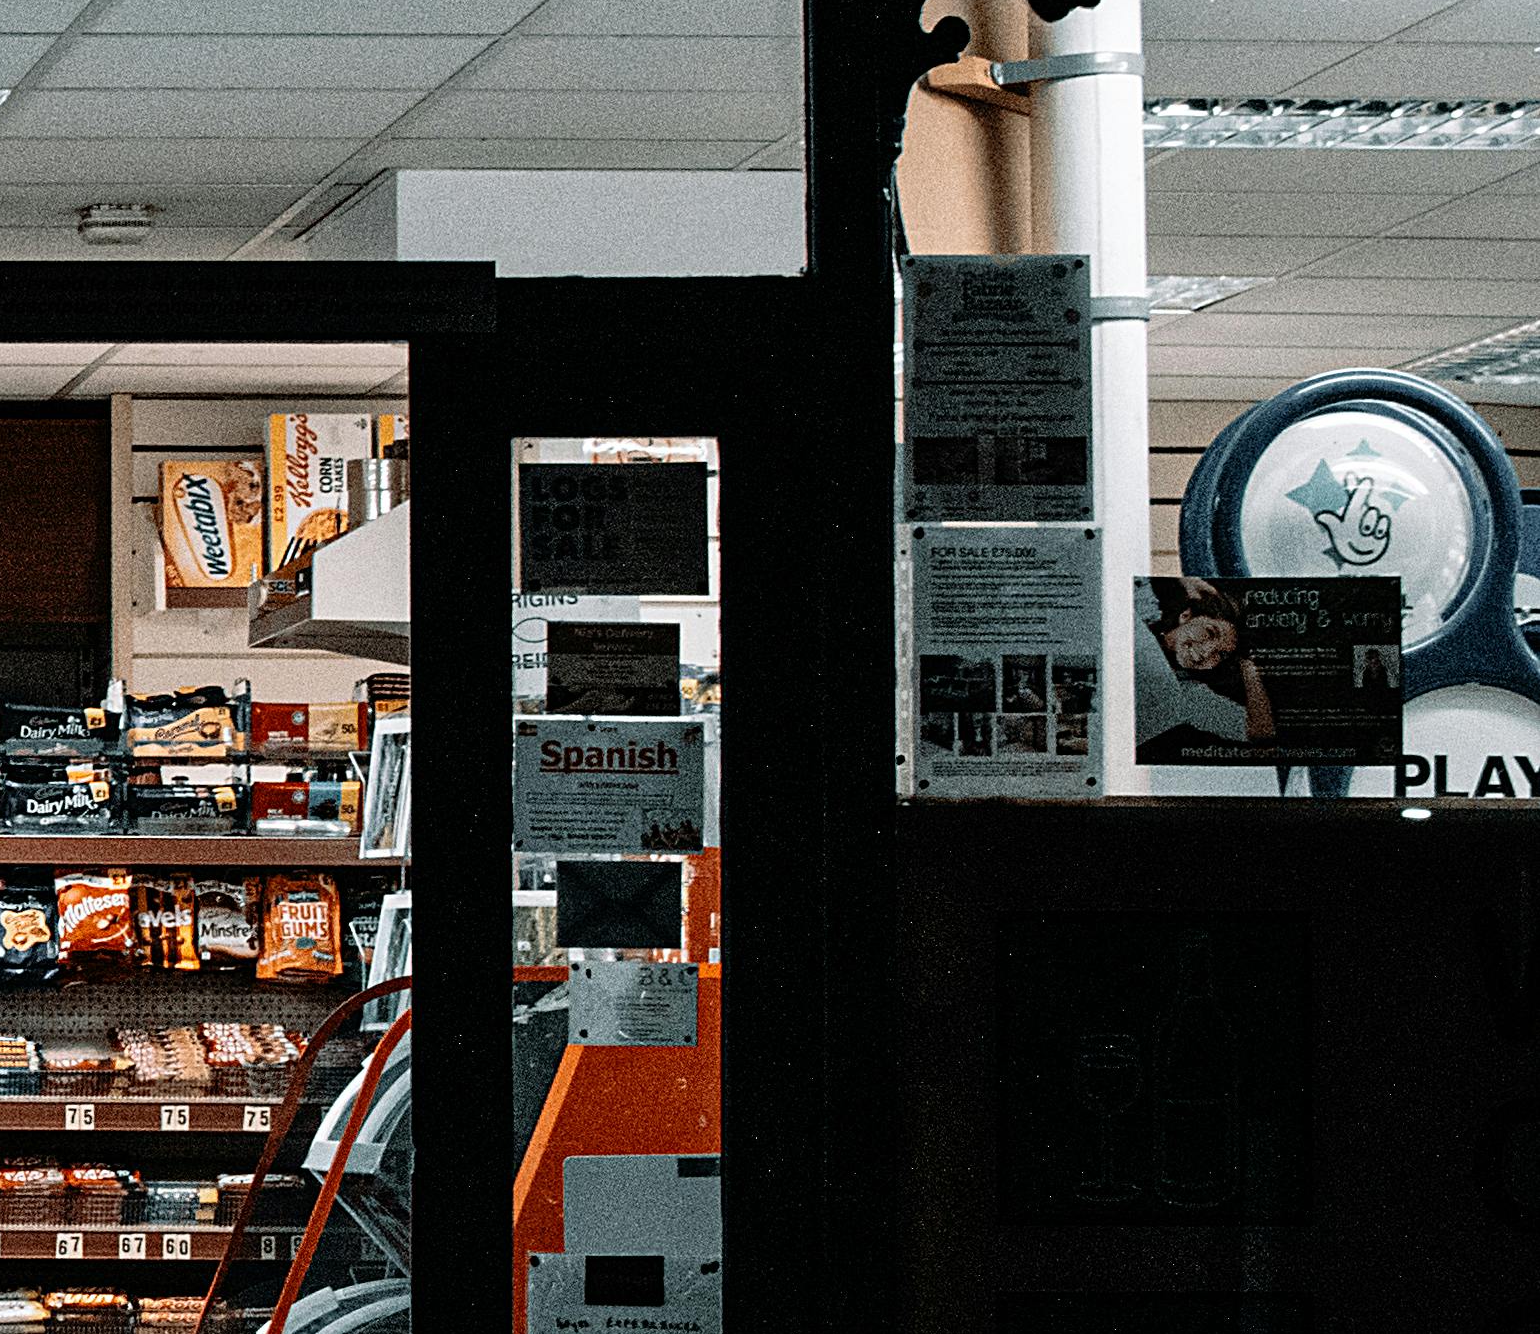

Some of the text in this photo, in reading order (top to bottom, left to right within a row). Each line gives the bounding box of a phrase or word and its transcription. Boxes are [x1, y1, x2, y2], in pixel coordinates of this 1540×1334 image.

[285, 413, 319, 509] Kellogg's
[319, 456, 333, 495] CORN
[334, 457, 345, 495] FLAKES
[531, 475, 627, 501] LOGS
[273, 485, 287, 522] £2.99
[181, 471, 229, 576] Weetabix
[531, 505, 607, 531] FOR
[531, 533, 620, 561] SALE
[930, 547, 989, 558] FOR SALE
[511, 593, 579, 609] RIGINS
[1242, 586, 1321, 612] reducing
[1244, 609, 1395, 634] anxiety & worry
[20, 717, 90, 741] Dairy Milk
[539, 739, 680, 773] Spanish
[26, 788, 98, 815] Dairy Milk
[94, 788, 107, 800] £1
[138, 907, 192, 928] evels
[280, 902, 330, 922] FRUIT
[281, 920, 329, 941] GUMS
[67, 1107, 93, 1125] 75
[163, 1108, 188, 1125] 75
[246, 1109, 270, 1127] 75
[58, 1235, 81, 1255] 67
[121, 1236, 144, 1253] 67
[165, 1238, 189, 1256] 60
